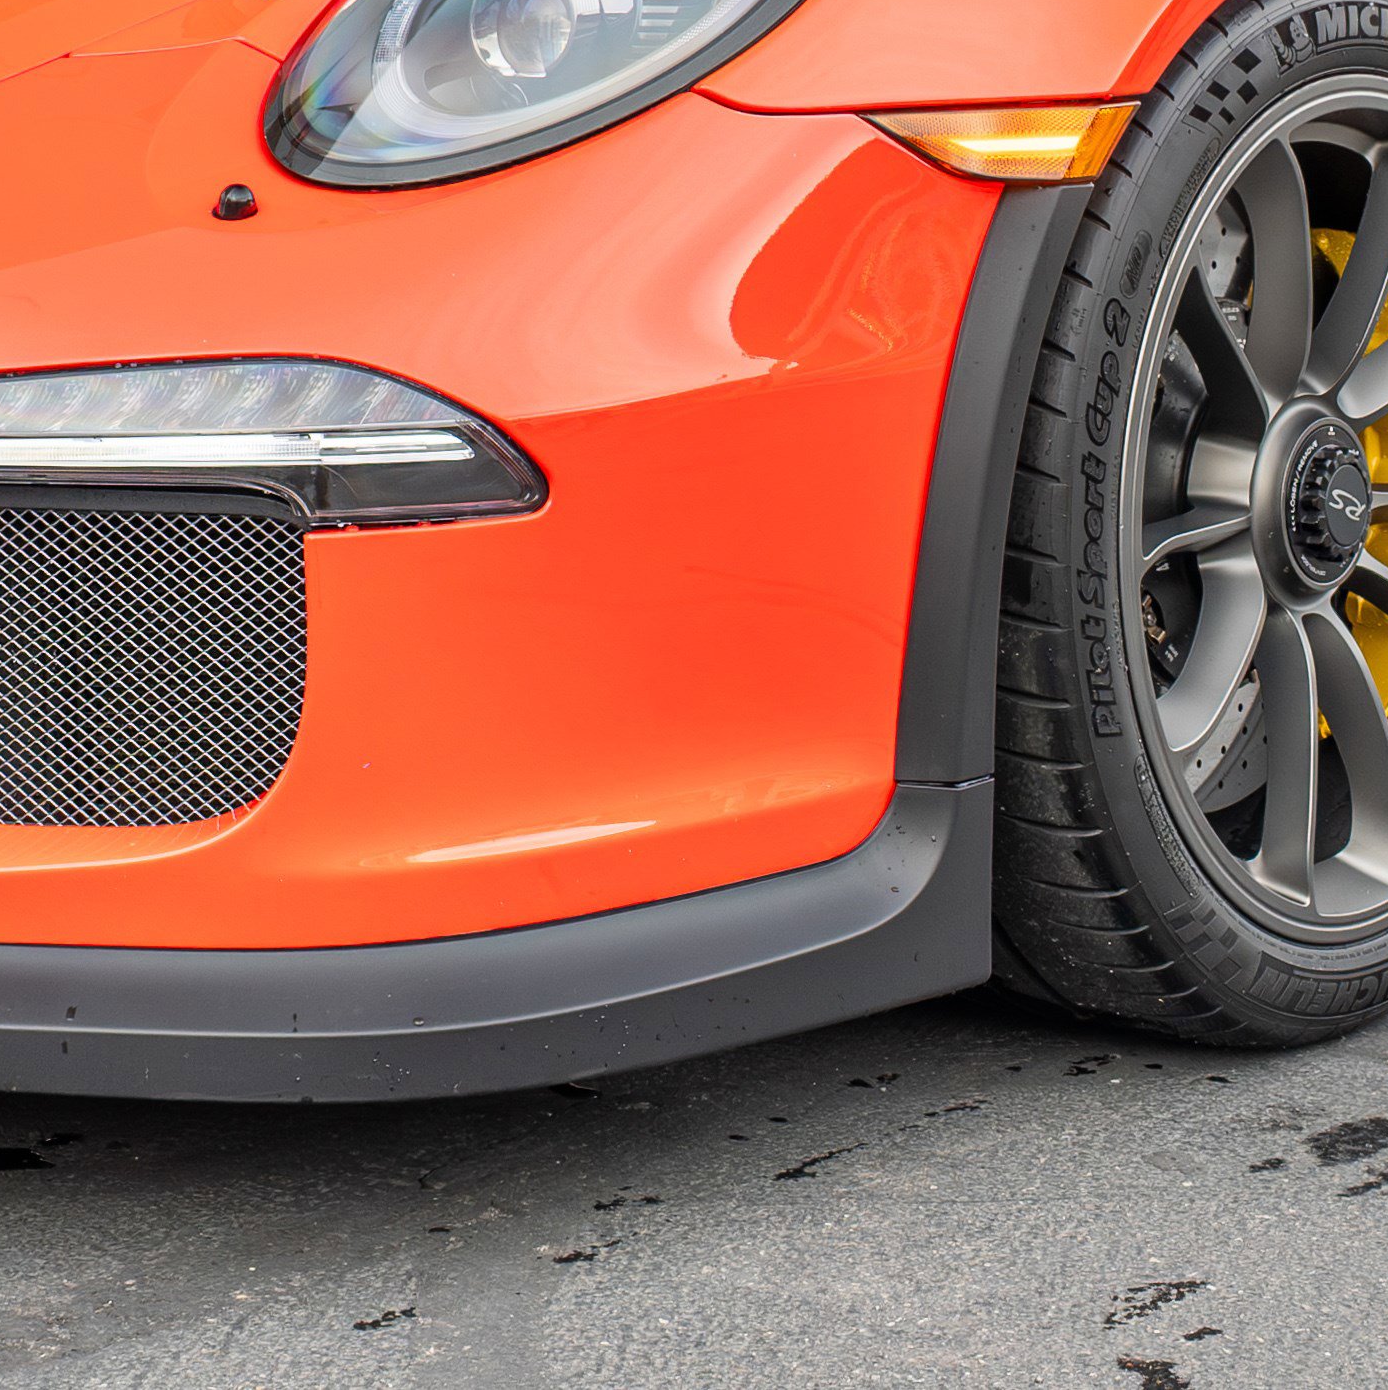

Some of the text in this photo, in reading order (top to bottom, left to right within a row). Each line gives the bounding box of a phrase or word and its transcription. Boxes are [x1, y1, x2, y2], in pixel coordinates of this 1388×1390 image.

[1076, 297, 1131, 738] Pilot Sport Cup 2
[1328, 488, 1366, 521] RS
